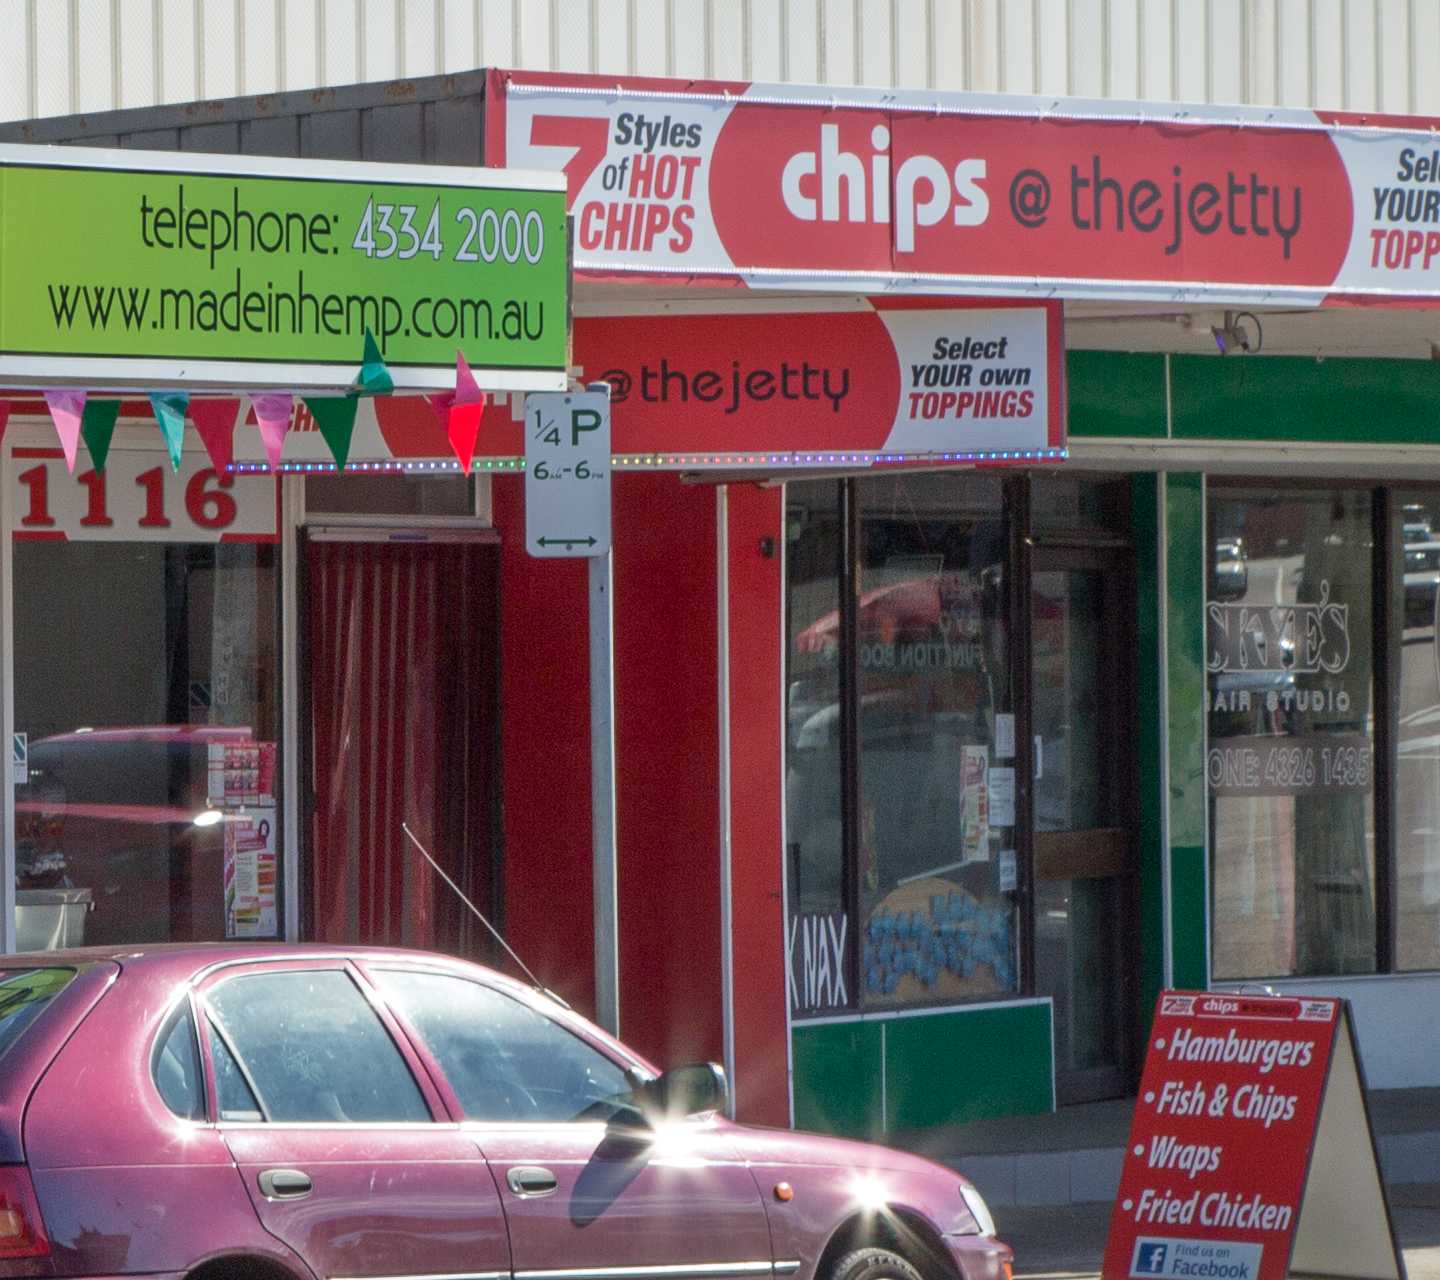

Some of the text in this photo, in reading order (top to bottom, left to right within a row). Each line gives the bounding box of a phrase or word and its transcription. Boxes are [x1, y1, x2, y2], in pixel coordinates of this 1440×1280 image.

[613, 112, 702, 151] Styles
[602, 154, 701, 200] of HOT
[1396, 148, 1440, 184] Sel
[781, 123, 989, 254] chips
[1009, 168, 1052, 226] @
[1373, 186, 1440, 224] YOUR
[141, 186, 545, 270] telephone: 4334 2000
[578, 200, 696, 255] CHIPS
[49, 268, 545, 352] www.madeinhemp.com.au
[932, 335, 1007, 362] Select
[600, 369, 633, 404] @
[910, 363, 1032, 390] YOUR own
[907, 388, 1035, 421] TOPPINGS
[571, 409, 602, 446] P
[20, 462, 238, 529] 1116
[1266, 691, 1350, 712] STUDIO
[1264, 747, 1316, 787] 4326
[1321, 746, 1371, 787] 1435
[1203, 998, 1239, 1014] chips
[1168, 1028, 1315, 1073] Hamburgers
[1156, 1081, 1298, 1128] Fish & Chips
[1148, 1135, 1222, 1179] Wraps
[1135, 1189, 1292, 1231] Fried Chicken
[1171, 1260, 1249, 1280] Facebook
[1175, 1243, 1200, 1257] Find
[1202, 1247, 1213, 1257] us
[1216, 1247, 1230, 1258] on
